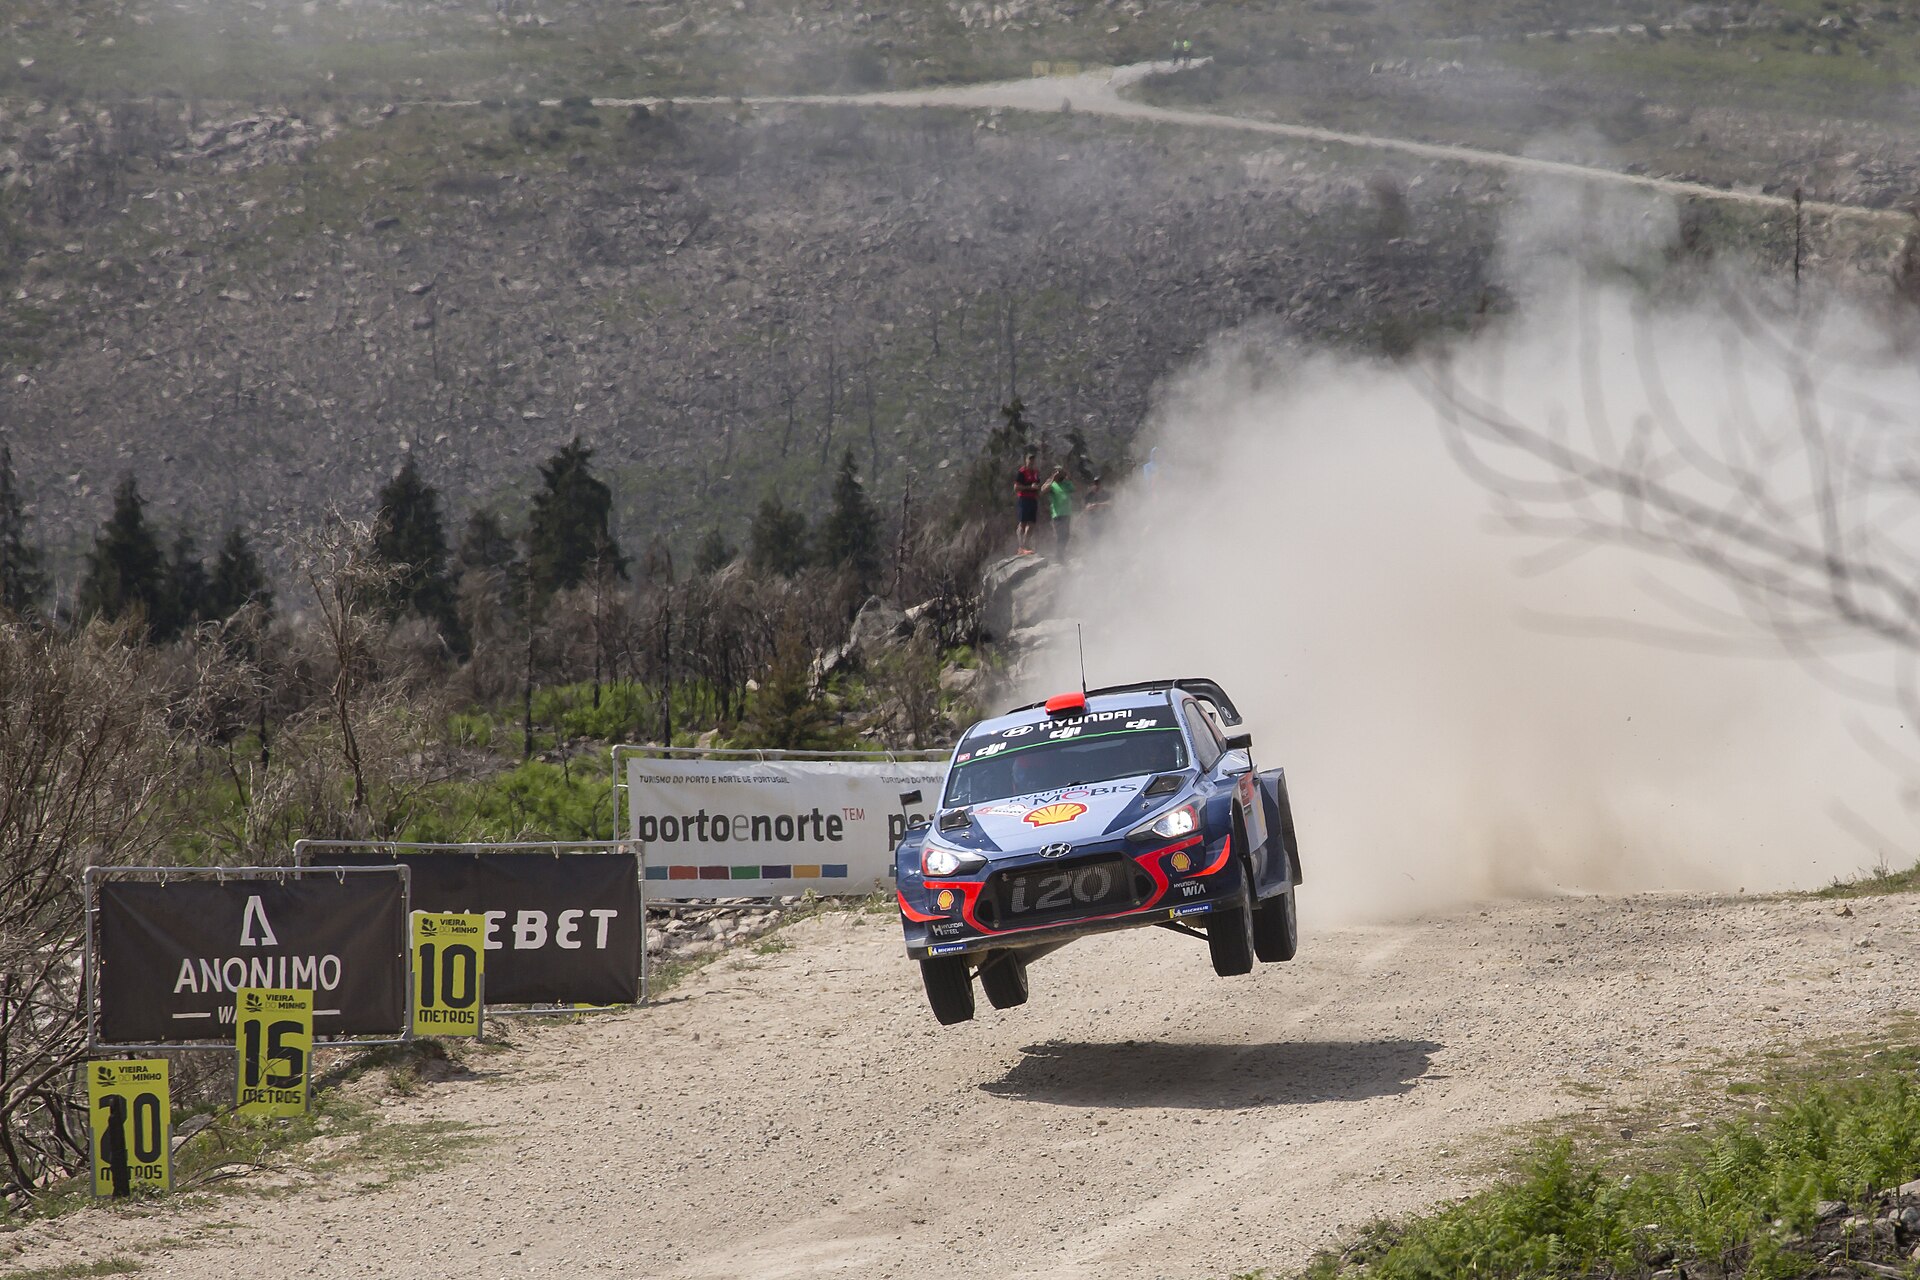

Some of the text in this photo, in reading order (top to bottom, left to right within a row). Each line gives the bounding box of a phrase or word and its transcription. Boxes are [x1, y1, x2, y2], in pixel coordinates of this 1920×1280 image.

[1039, 709, 1132, 731] HYUNDAI
[639, 775, 671, 784] TURISMO
[672, 775, 684, 784] DO
[685, 775, 710, 784] PORTO
[711, 775, 717, 784] E
[718, 775, 741, 784] NORTE
[753, 776, 790, 784] PORTUGAL
[880, 776, 910, 784] TURISMO
[1033, 783, 1138, 806] MOBIS
[842, 807, 865, 821] TEM
[439, 918, 467, 927] VIEIRA
[173, 954, 342, 994] ANONIMO
[419, 943, 477, 1009] 10
[265, 993, 295, 1002] VIEIRA
[278, 1002, 306, 1010] MINHO
[419, 1009, 475, 1024] METROS
[244, 1019, 305, 1089] 15
[118, 1065, 149, 1074] VIEIRA
[132, 1072, 162, 1081] MINHO
[242, 1088, 302, 1105] METROS
